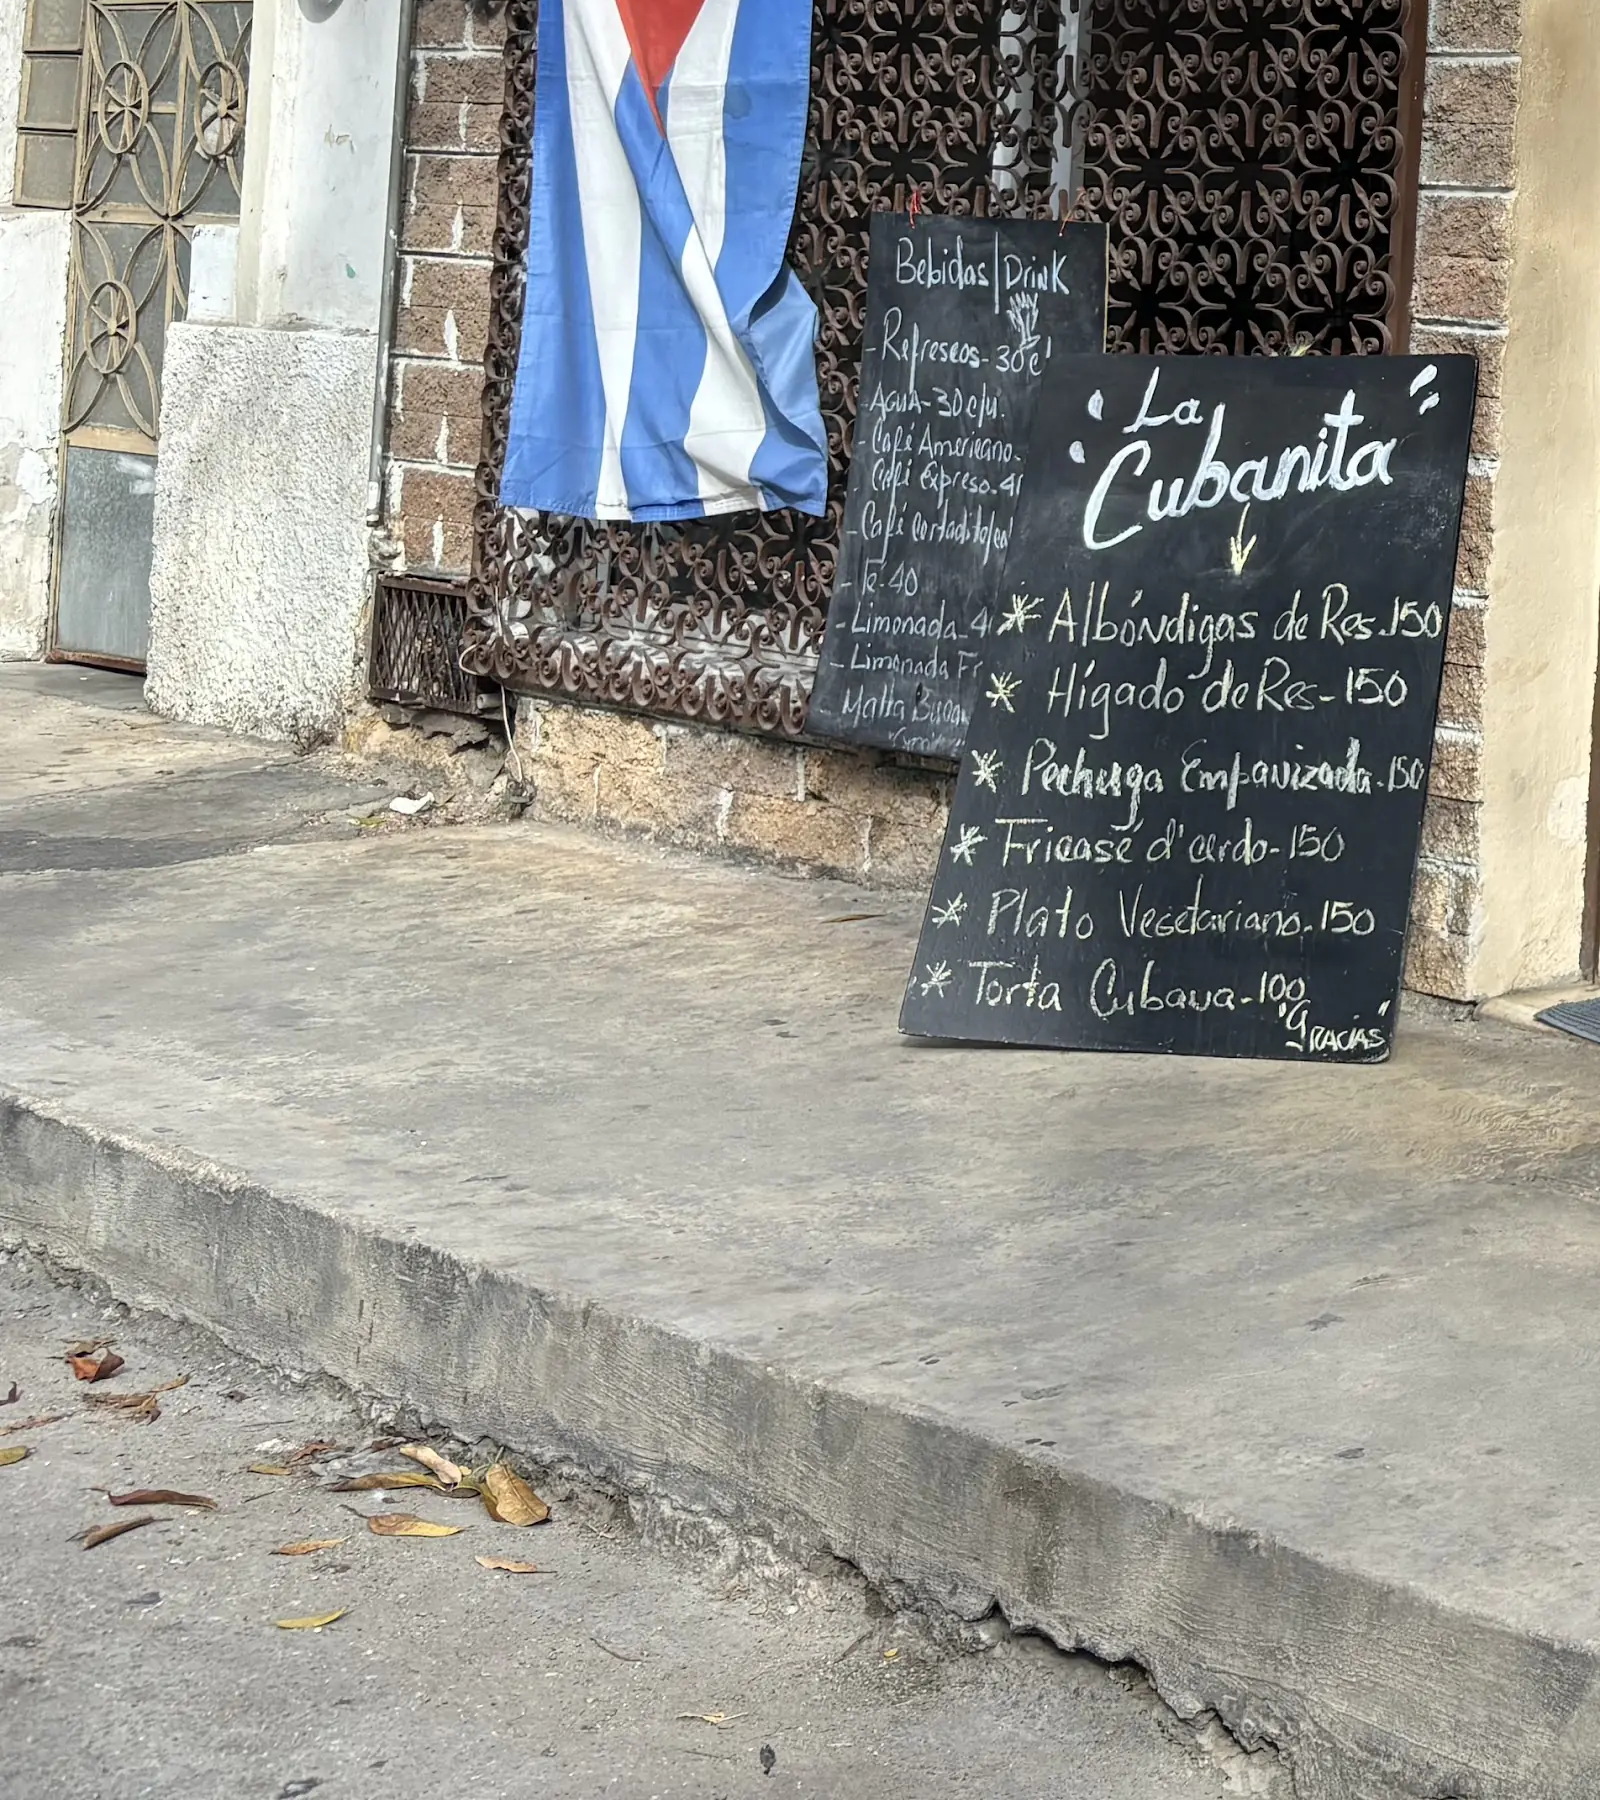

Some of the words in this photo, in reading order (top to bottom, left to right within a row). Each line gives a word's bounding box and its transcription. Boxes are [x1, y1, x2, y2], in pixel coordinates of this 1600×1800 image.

[896, 235, 989, 290] Bebidas
[872, 417, 915, 475] Café
[888, 560, 918, 596] 40
[1048, 580, 1259, 680] Albóndigas
[1273, 589, 1308, 642] de
[850, 643, 949, 680] Limonada
[842, 677, 905, 729] Malta
[1047, 657, 1185, 740] Hígado
[1202, 659, 1245, 713] de
[987, 883, 1095, 940] Plato
[968, 954, 1063, 1012] Torta
